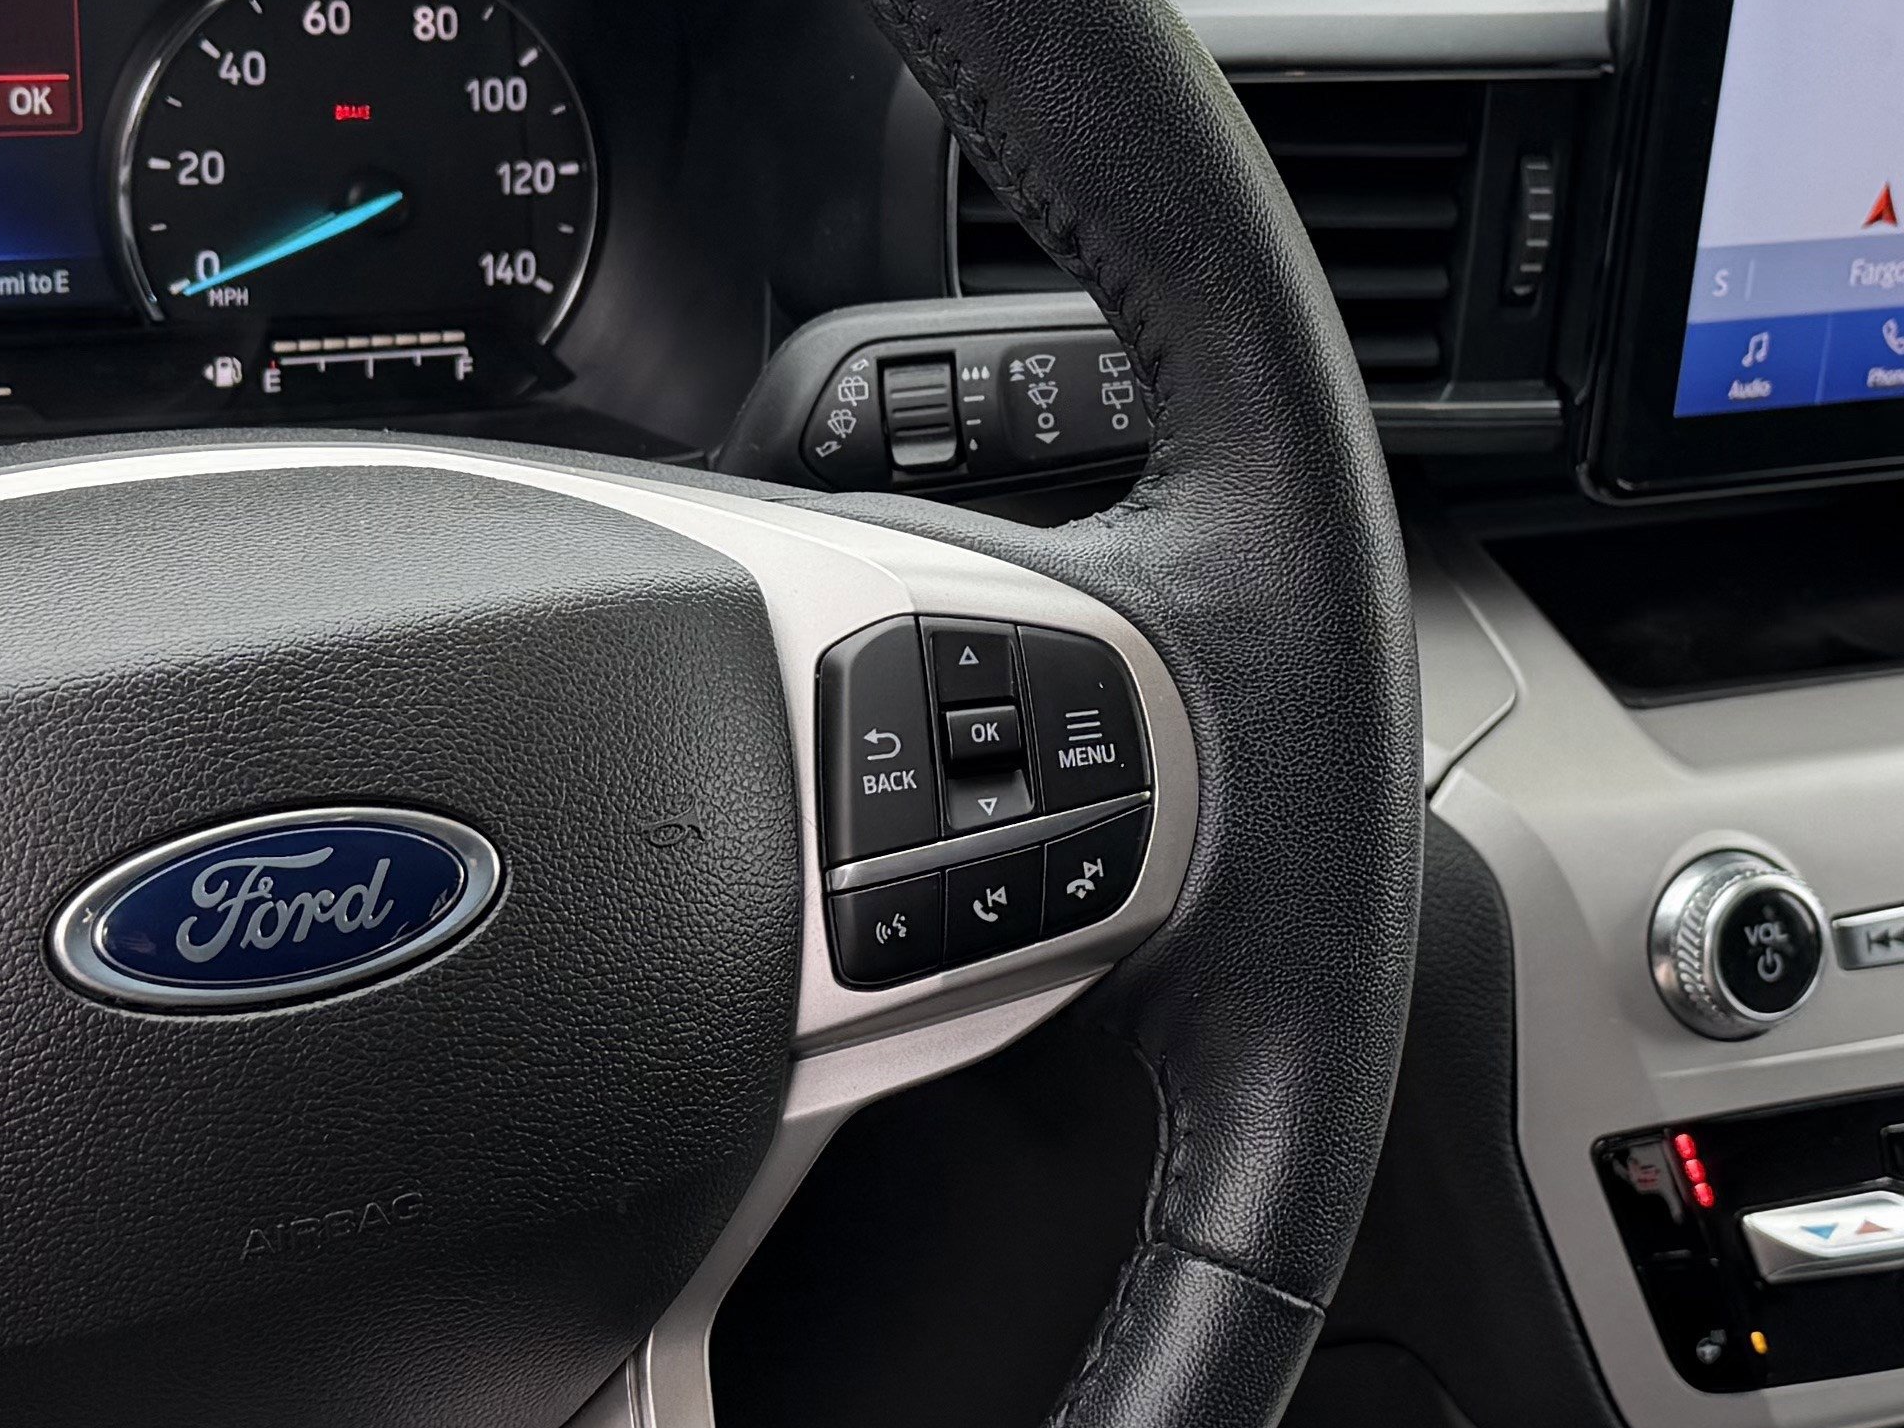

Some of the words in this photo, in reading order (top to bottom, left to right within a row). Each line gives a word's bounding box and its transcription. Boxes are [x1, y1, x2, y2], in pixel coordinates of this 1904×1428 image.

[303, 0, 350, 36] 60
[411, 7, 458, 42] 80
[218, 50, 266, 87] 40
[8, 86, 53, 117] OK
[465, 77, 527, 113] 100
[177, 150, 224, 186] 20
[497, 159, 556, 194] 120
[28, 271, 51, 296] to
[53, 270, 71, 296] E
[479, 250, 537, 286] 140
[209, 286, 249, 308] MPH
[1729, 377, 1770, 400] Audio
[971, 723, 1000, 743] OK
[1058, 744, 1116, 769] MENU
[863, 770, 917, 794] BACK
[176, 846, 394, 963] Ford
[1744, 922, 1790, 947] VOL
